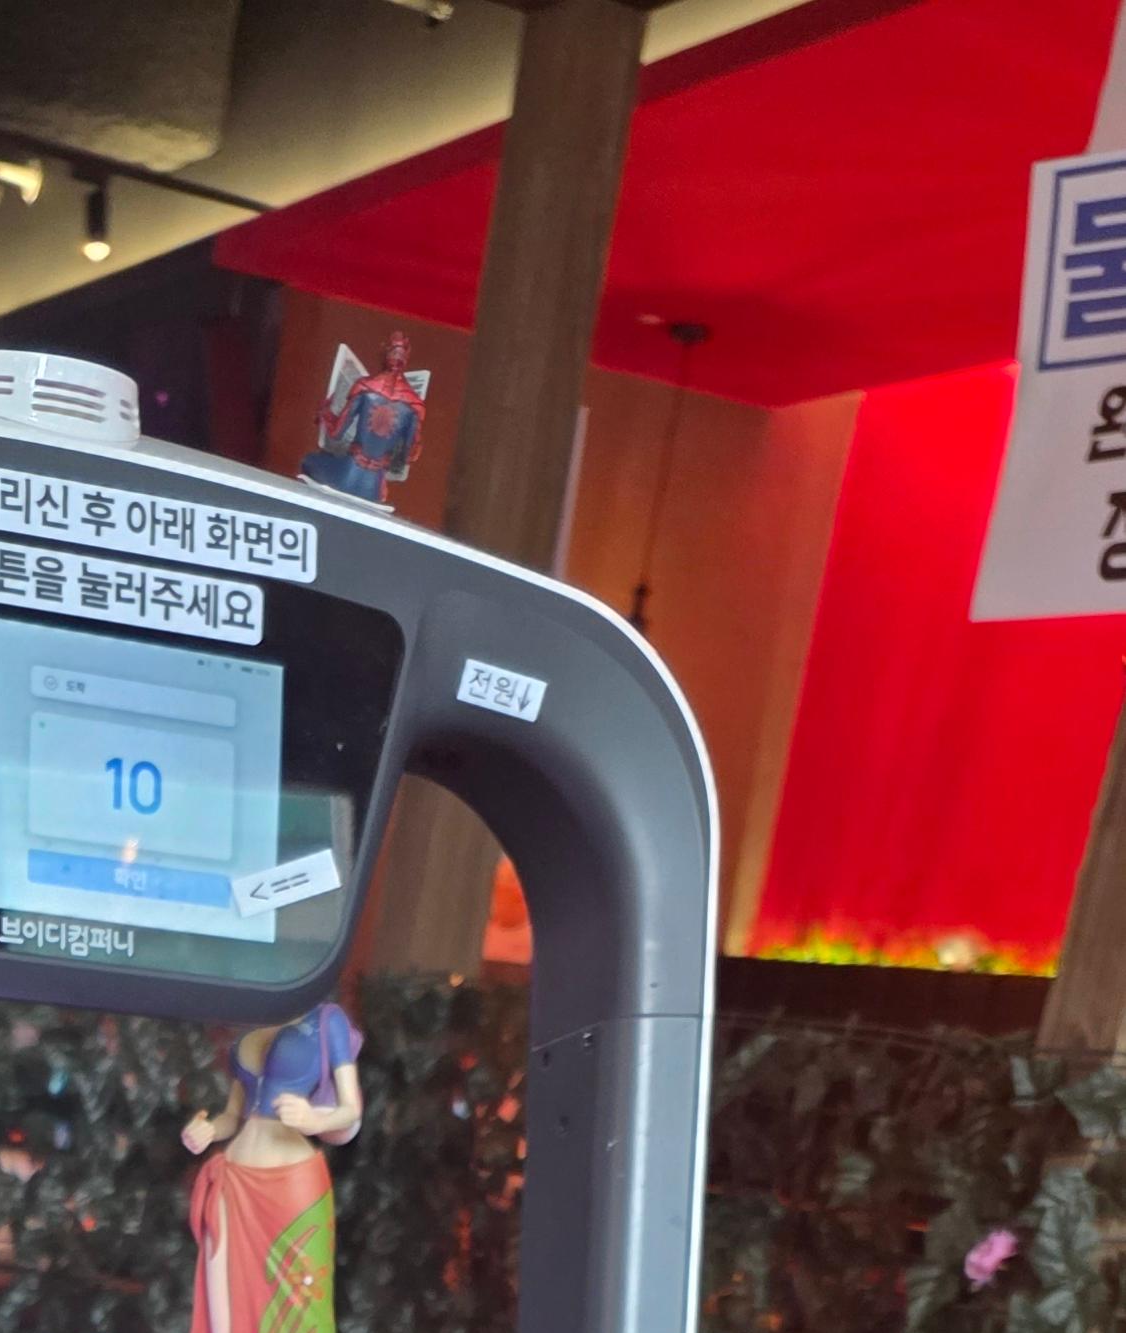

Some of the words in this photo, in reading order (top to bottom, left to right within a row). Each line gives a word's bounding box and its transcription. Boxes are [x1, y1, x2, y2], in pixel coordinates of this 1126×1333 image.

[80, 491, 117, 537] 후
[126, 500, 195, 553] 아래
[205, 512, 308, 573] 화면의
[77, 561, 256, 630] 눌러주세요
[468, 668, 519, 707] 전원
[105, 757, 163, 816] 10
